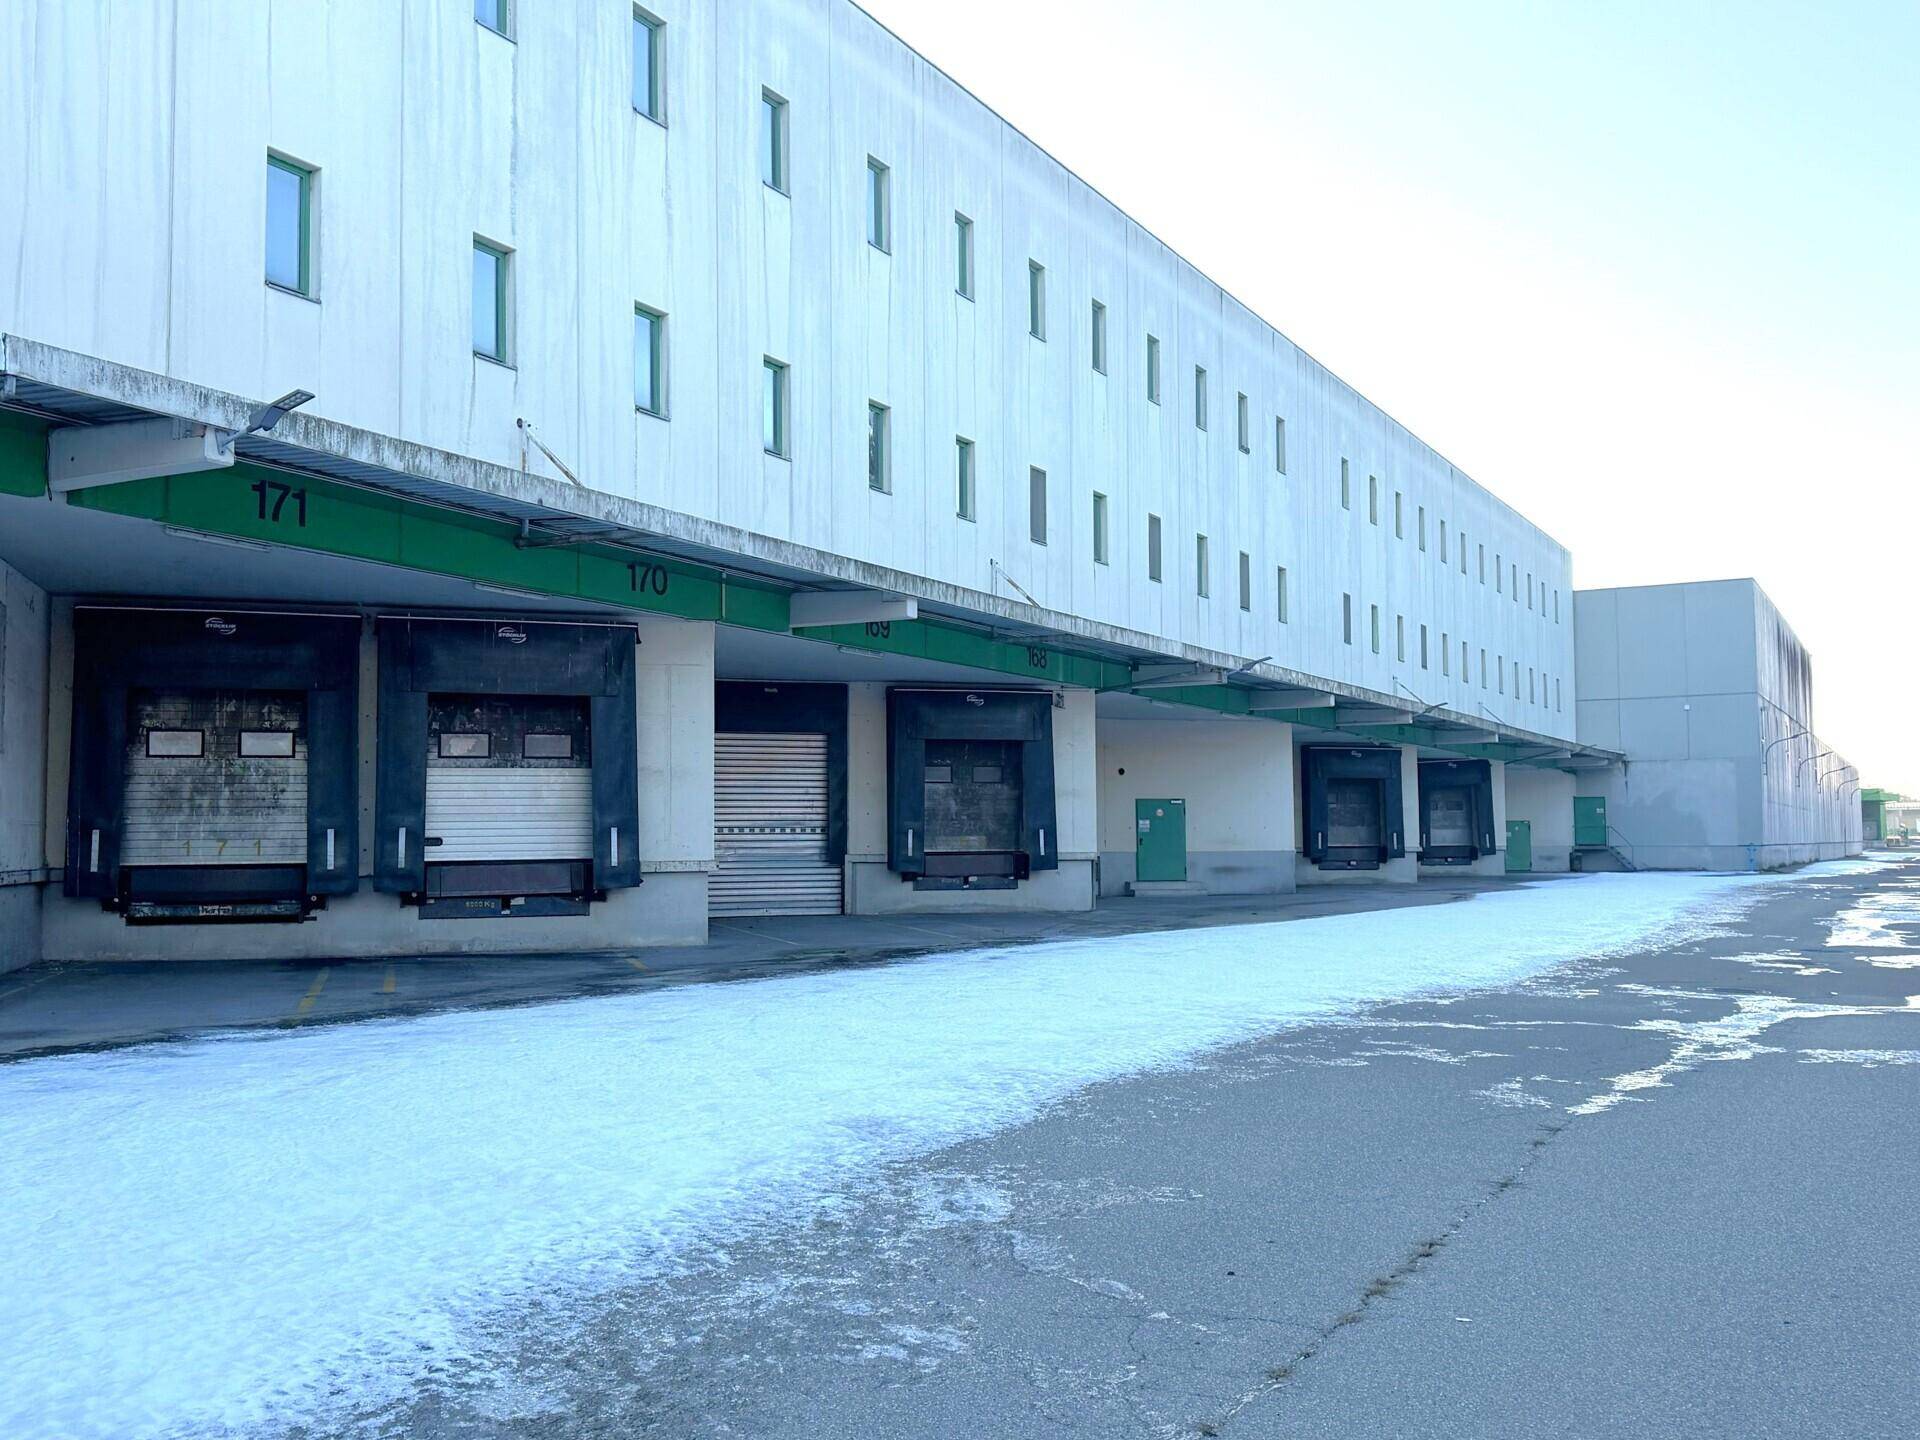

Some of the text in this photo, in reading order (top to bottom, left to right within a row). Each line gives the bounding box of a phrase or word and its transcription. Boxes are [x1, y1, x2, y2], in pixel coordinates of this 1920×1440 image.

[251, 479, 307, 528] 171
[626, 561, 668, 595] 170
[865, 620, 891, 638] 169
[1026, 646, 1047, 668] 168
